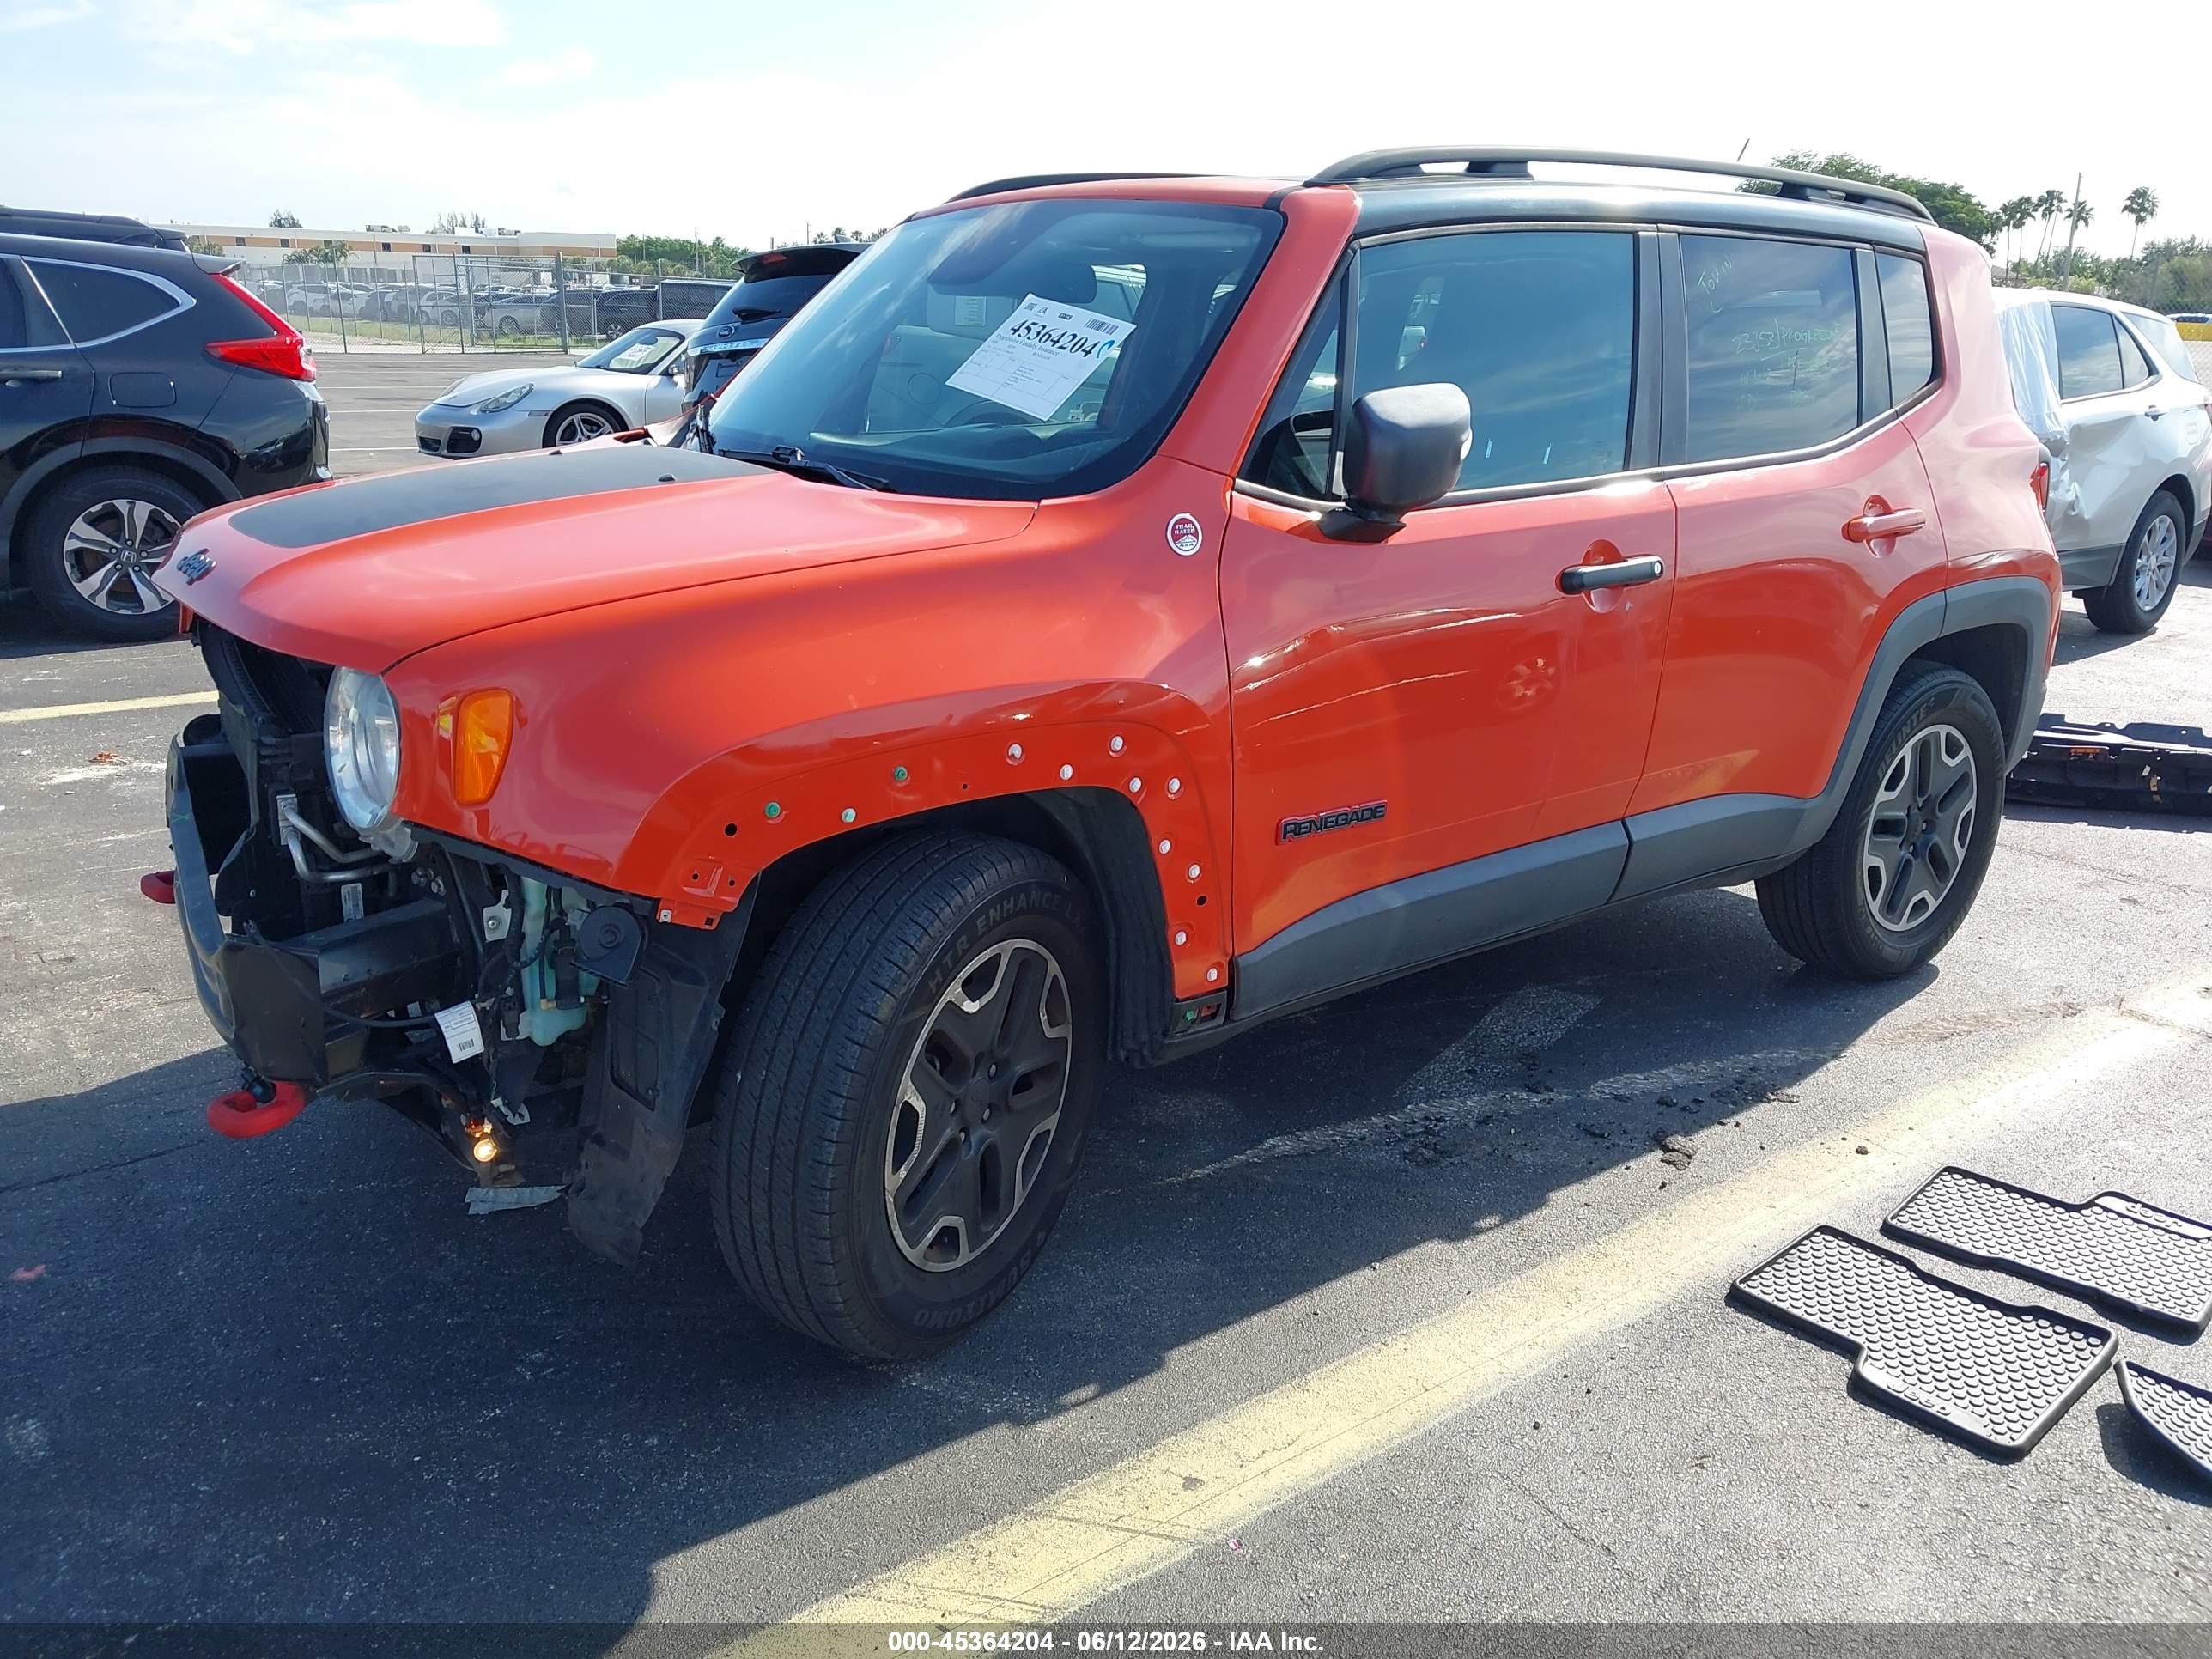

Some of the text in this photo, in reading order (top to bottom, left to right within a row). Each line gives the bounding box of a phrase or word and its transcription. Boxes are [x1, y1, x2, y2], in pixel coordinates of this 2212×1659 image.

[1010, 319, 1100, 358] 45364204
[1280, 801, 1388, 842] RENEGADE
[927, 935, 971, 994] HTR
[976, 890, 1062, 934] ENHANCE
[1886, 1380, 1952, 1417] Jeep
